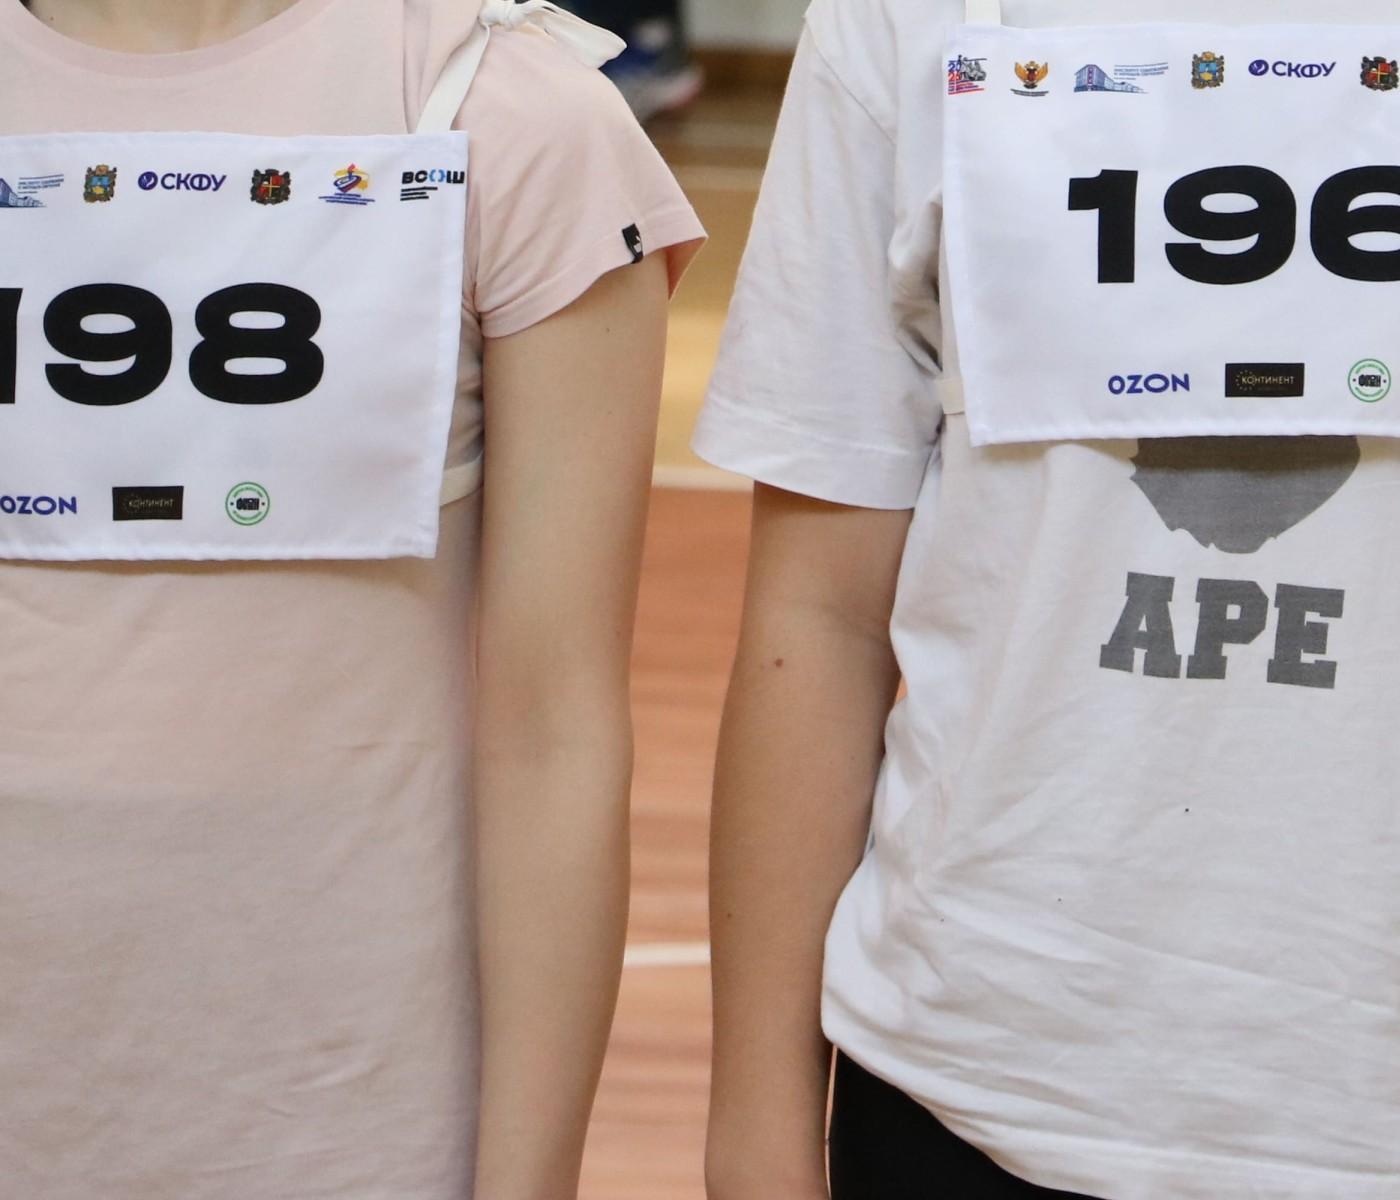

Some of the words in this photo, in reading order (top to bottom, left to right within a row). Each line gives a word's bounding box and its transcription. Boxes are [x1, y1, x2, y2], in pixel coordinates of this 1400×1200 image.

[1272, 61, 1336, 79] СКФУ
[161, 172, 226, 192] СКФУ
[1108, 373, 1190, 394] OZON
[1241, 376, 1294, 385] КОНТИНЕНТ
[0, 496, 77, 515] OZON
[1099, 572, 1345, 689] APE
